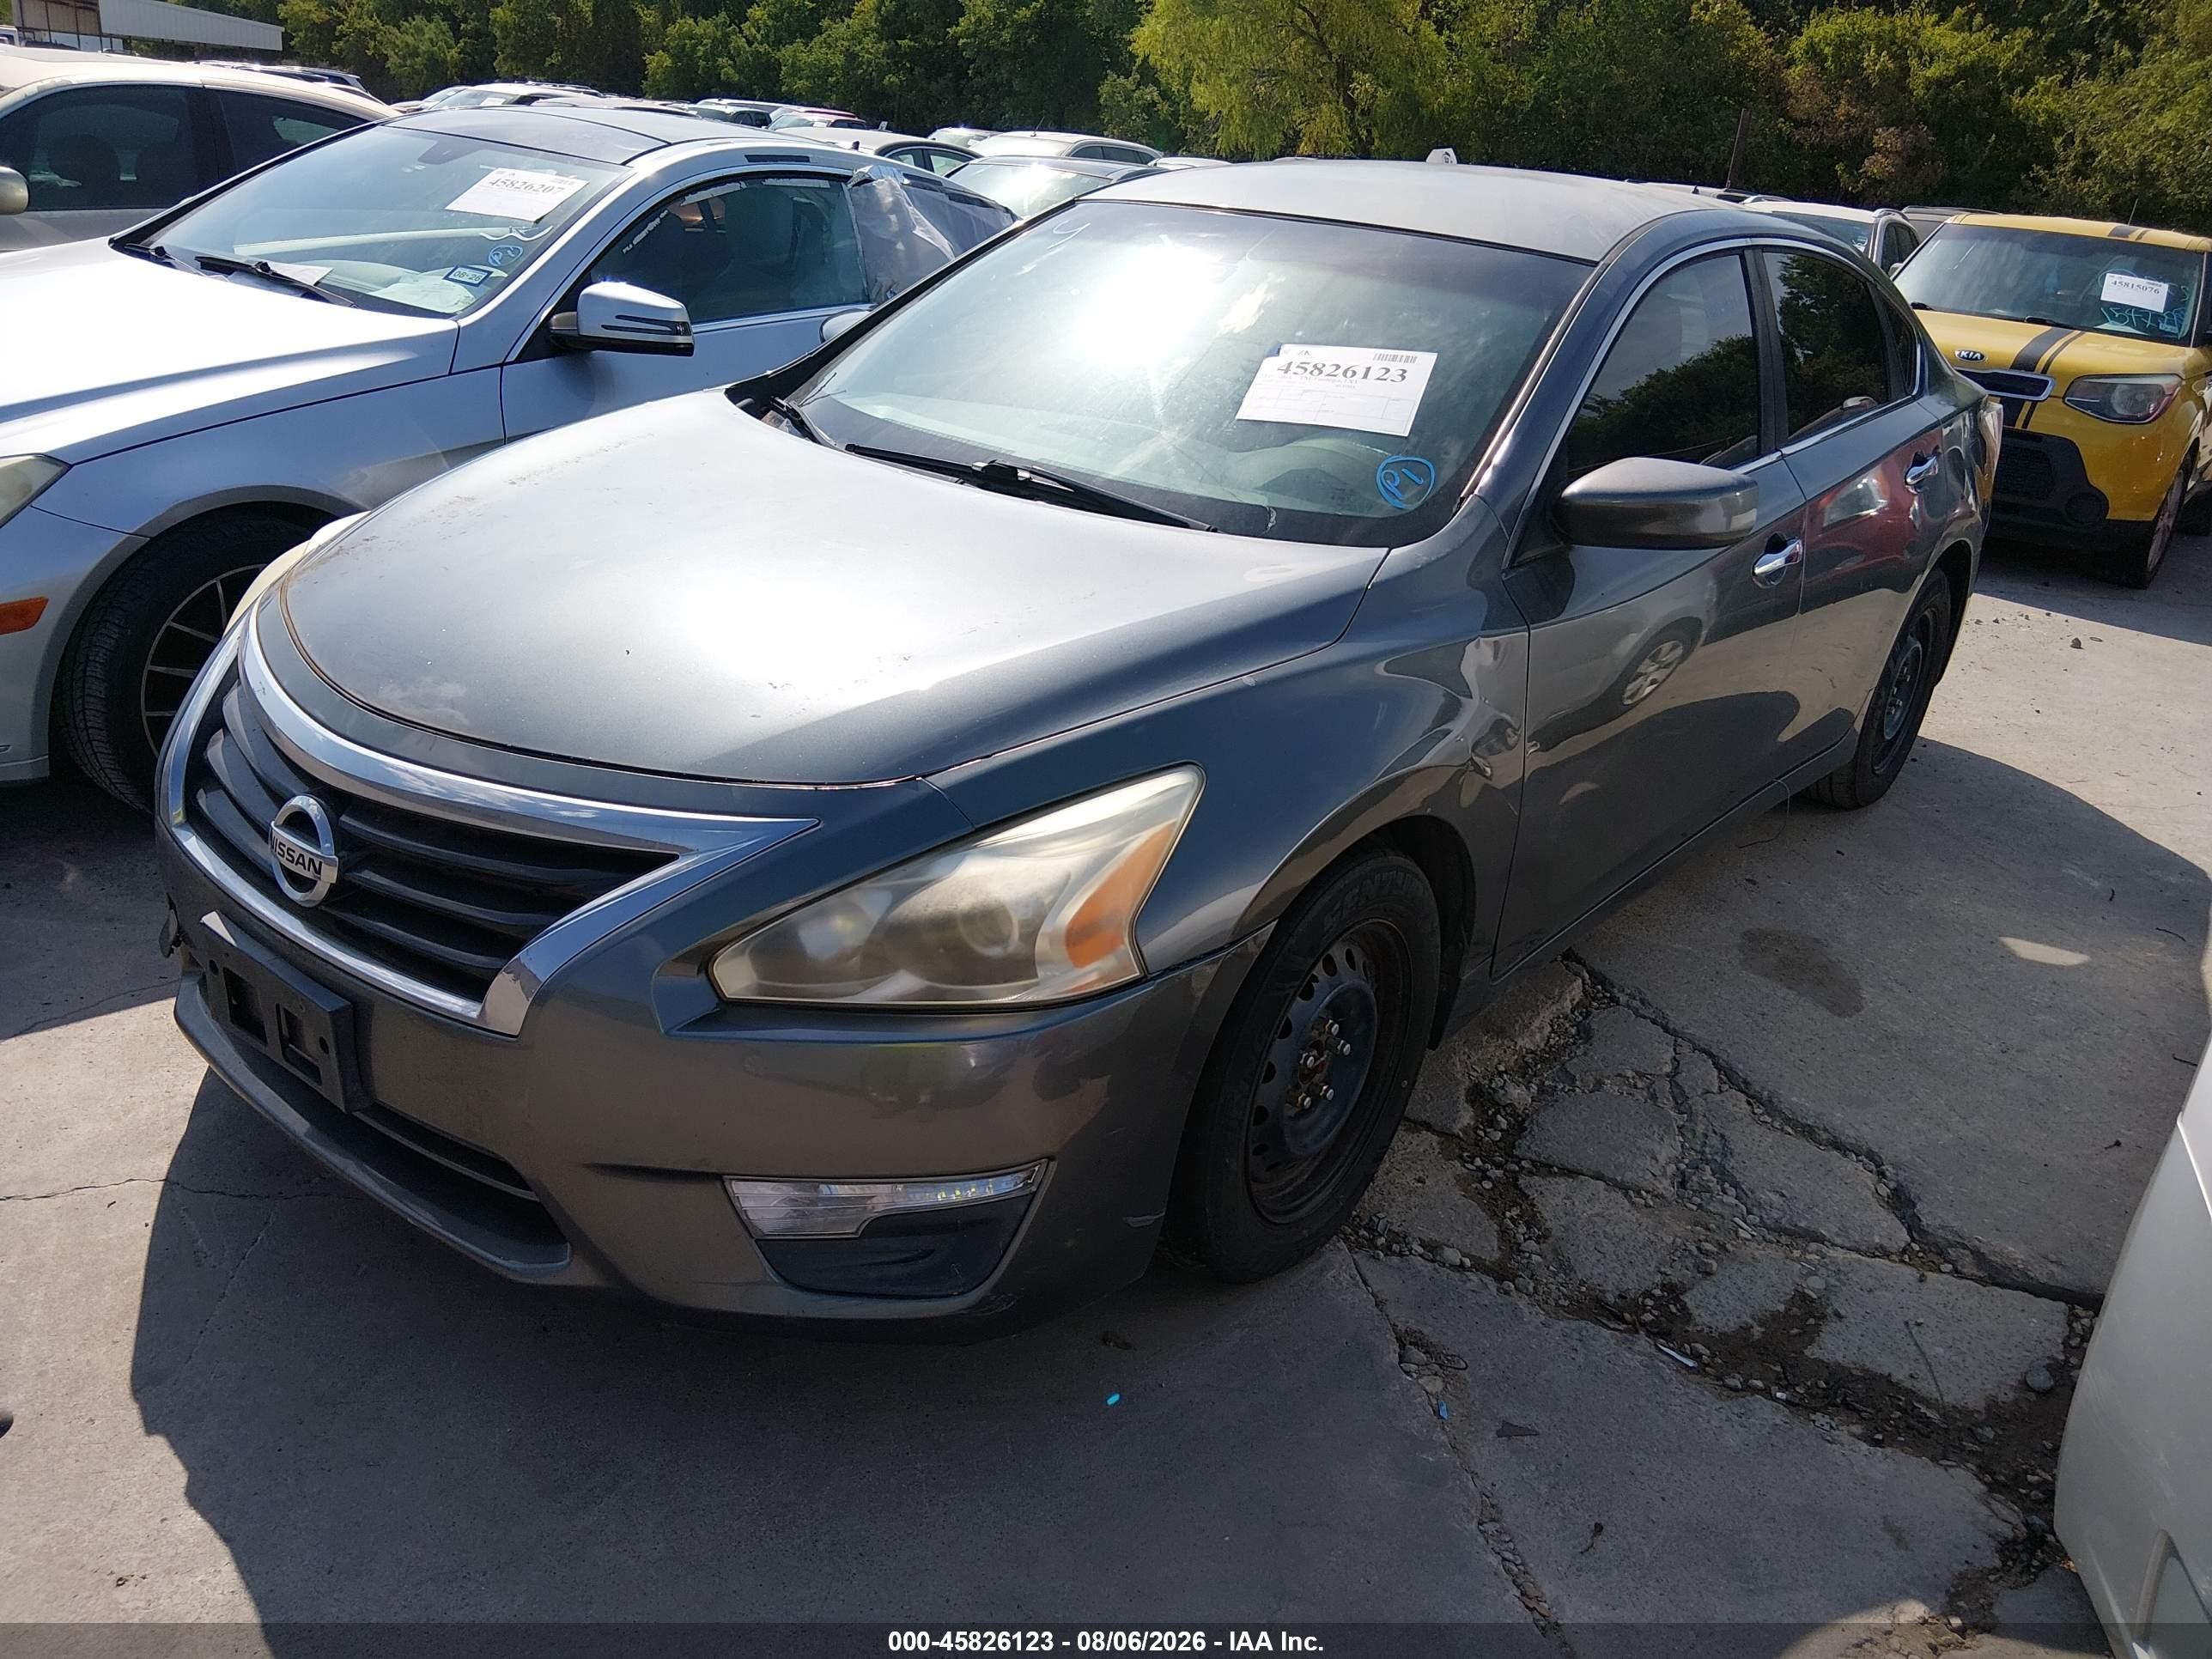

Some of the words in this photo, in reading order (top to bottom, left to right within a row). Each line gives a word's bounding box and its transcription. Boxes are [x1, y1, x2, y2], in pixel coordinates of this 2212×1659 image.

[488, 179, 567, 196] 45826207
[2111, 280, 2160, 295] 45815076
[1960, 350, 1982, 360] KIA
[1277, 361, 1408, 383] 45826123
[270, 834, 324, 876] NISSAN
